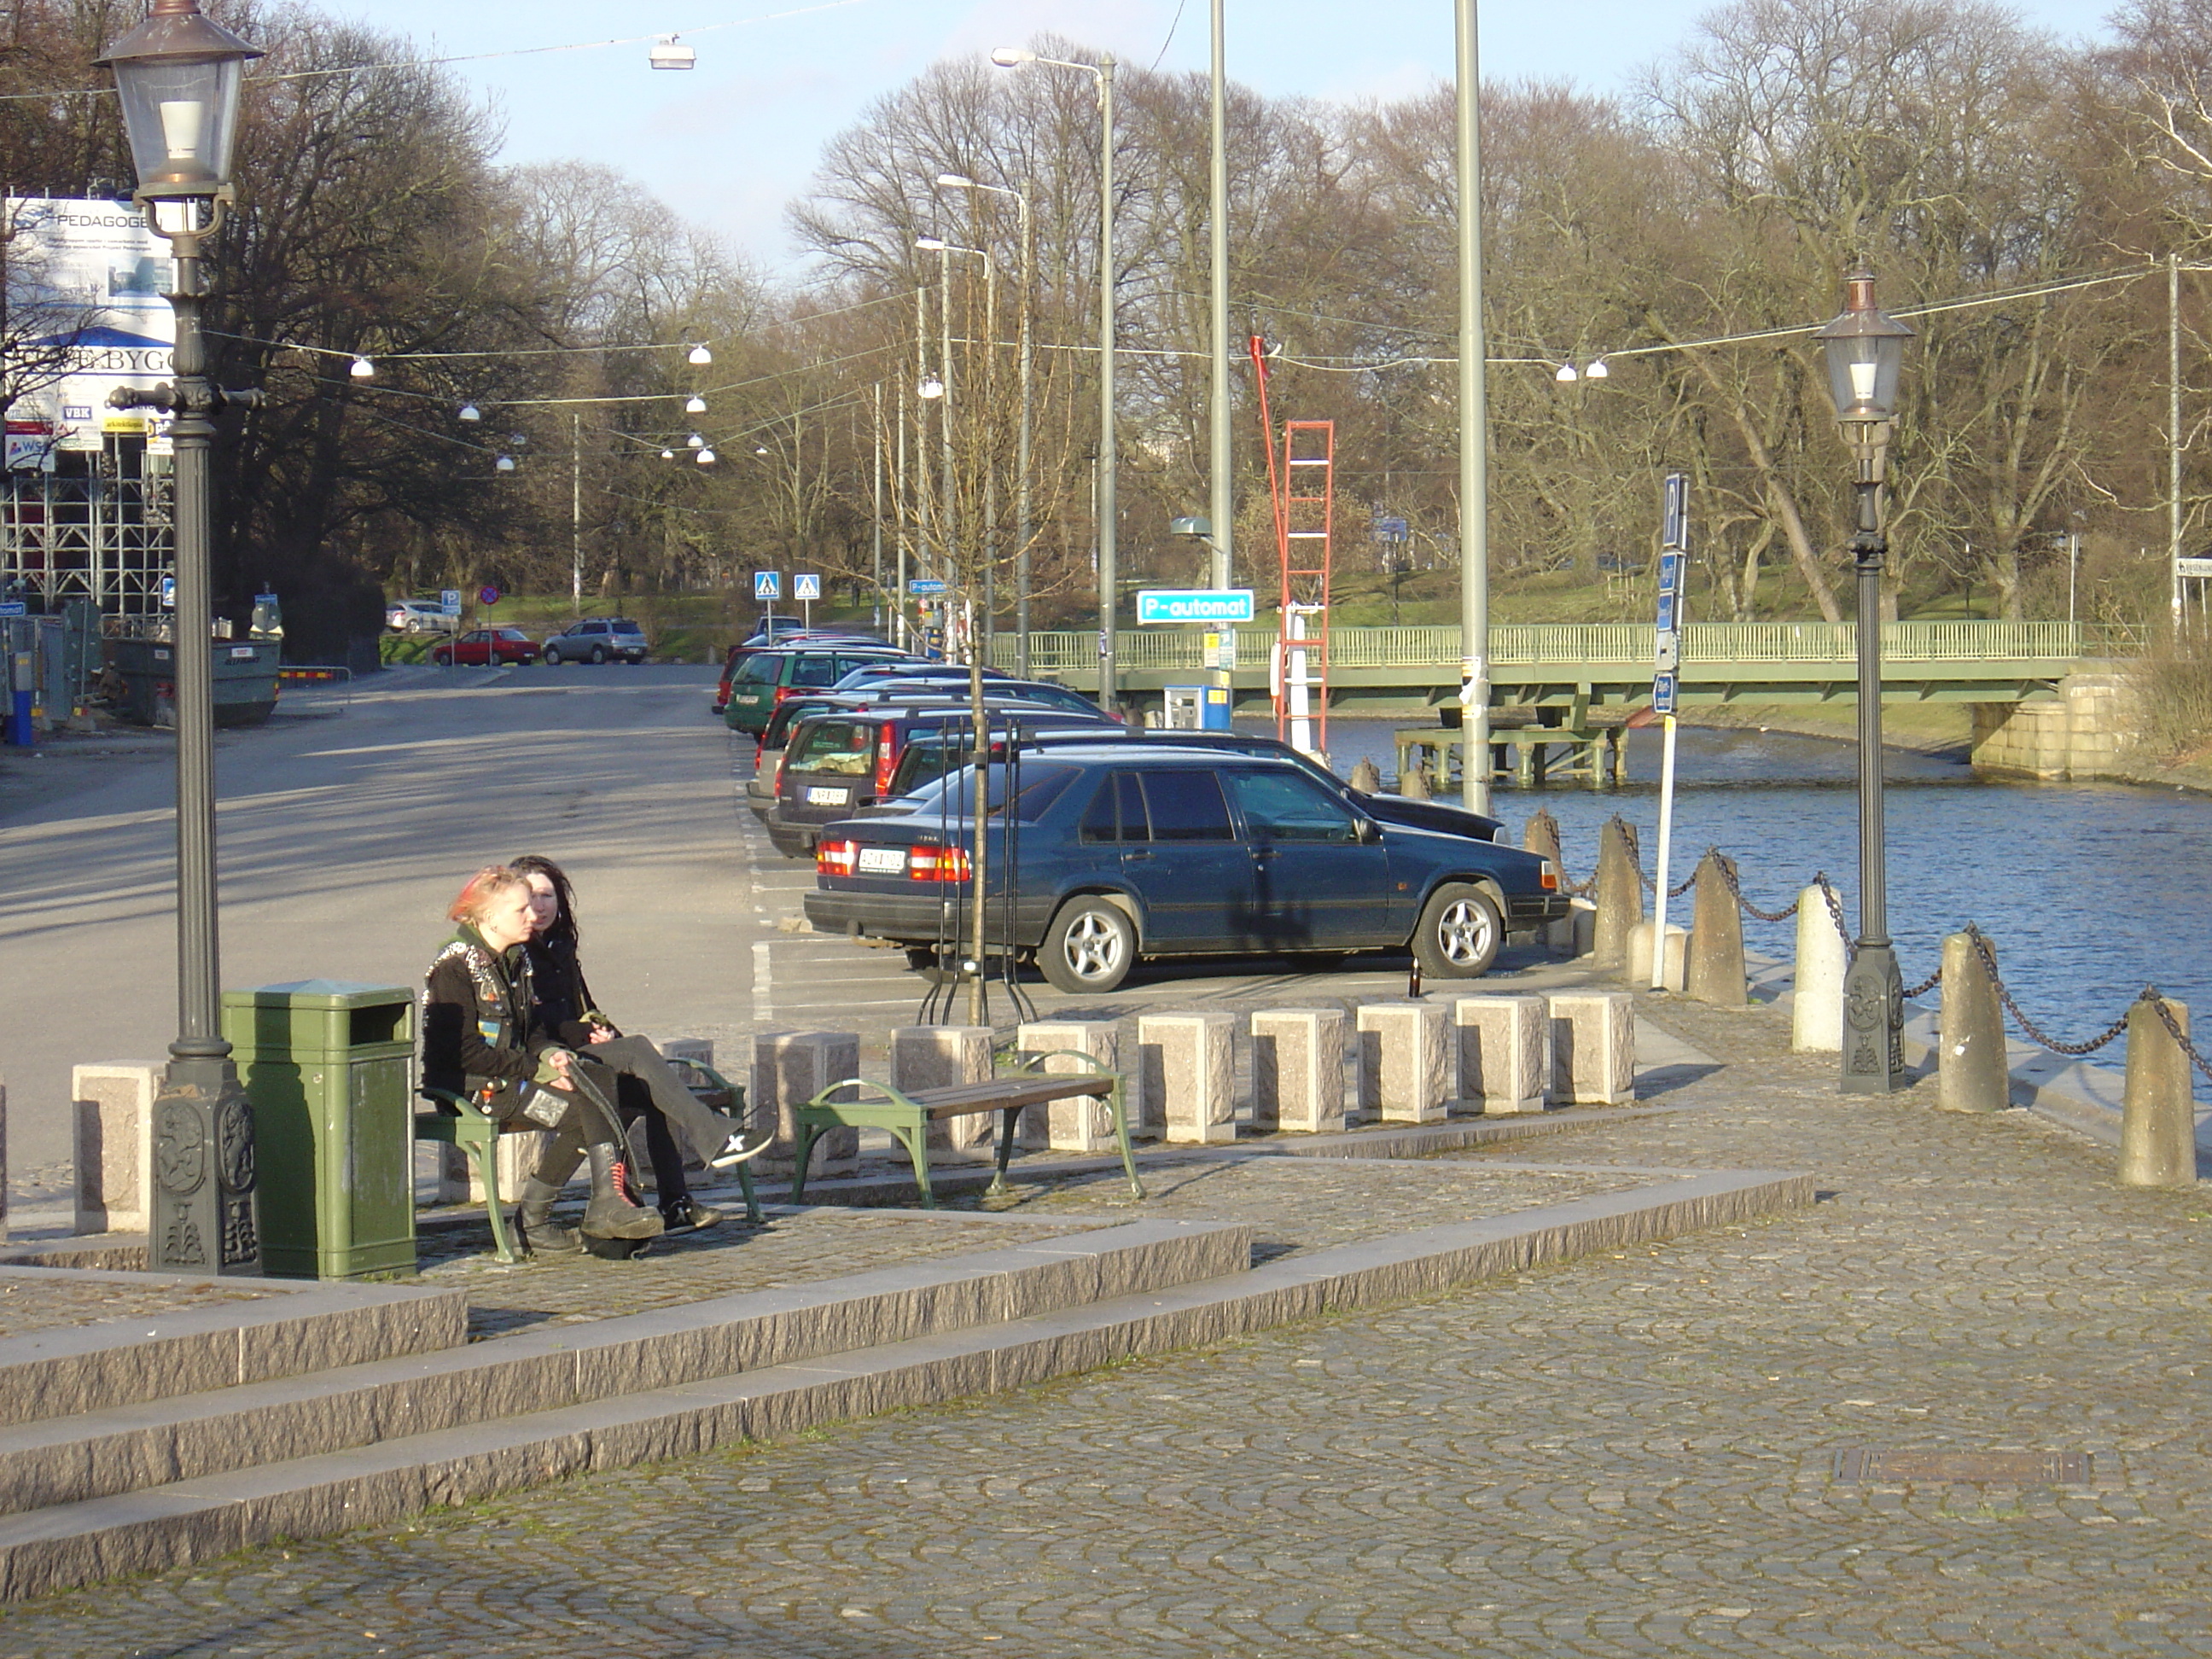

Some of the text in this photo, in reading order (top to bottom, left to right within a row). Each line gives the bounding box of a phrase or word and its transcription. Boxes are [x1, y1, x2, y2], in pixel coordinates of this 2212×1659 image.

[57, 215, 163, 229] PEDAGOGE
[65, 408, 90, 418] VBK
[912, 583, 948, 591] P-autom
[1144, 597, 1247, 616] P-automat
